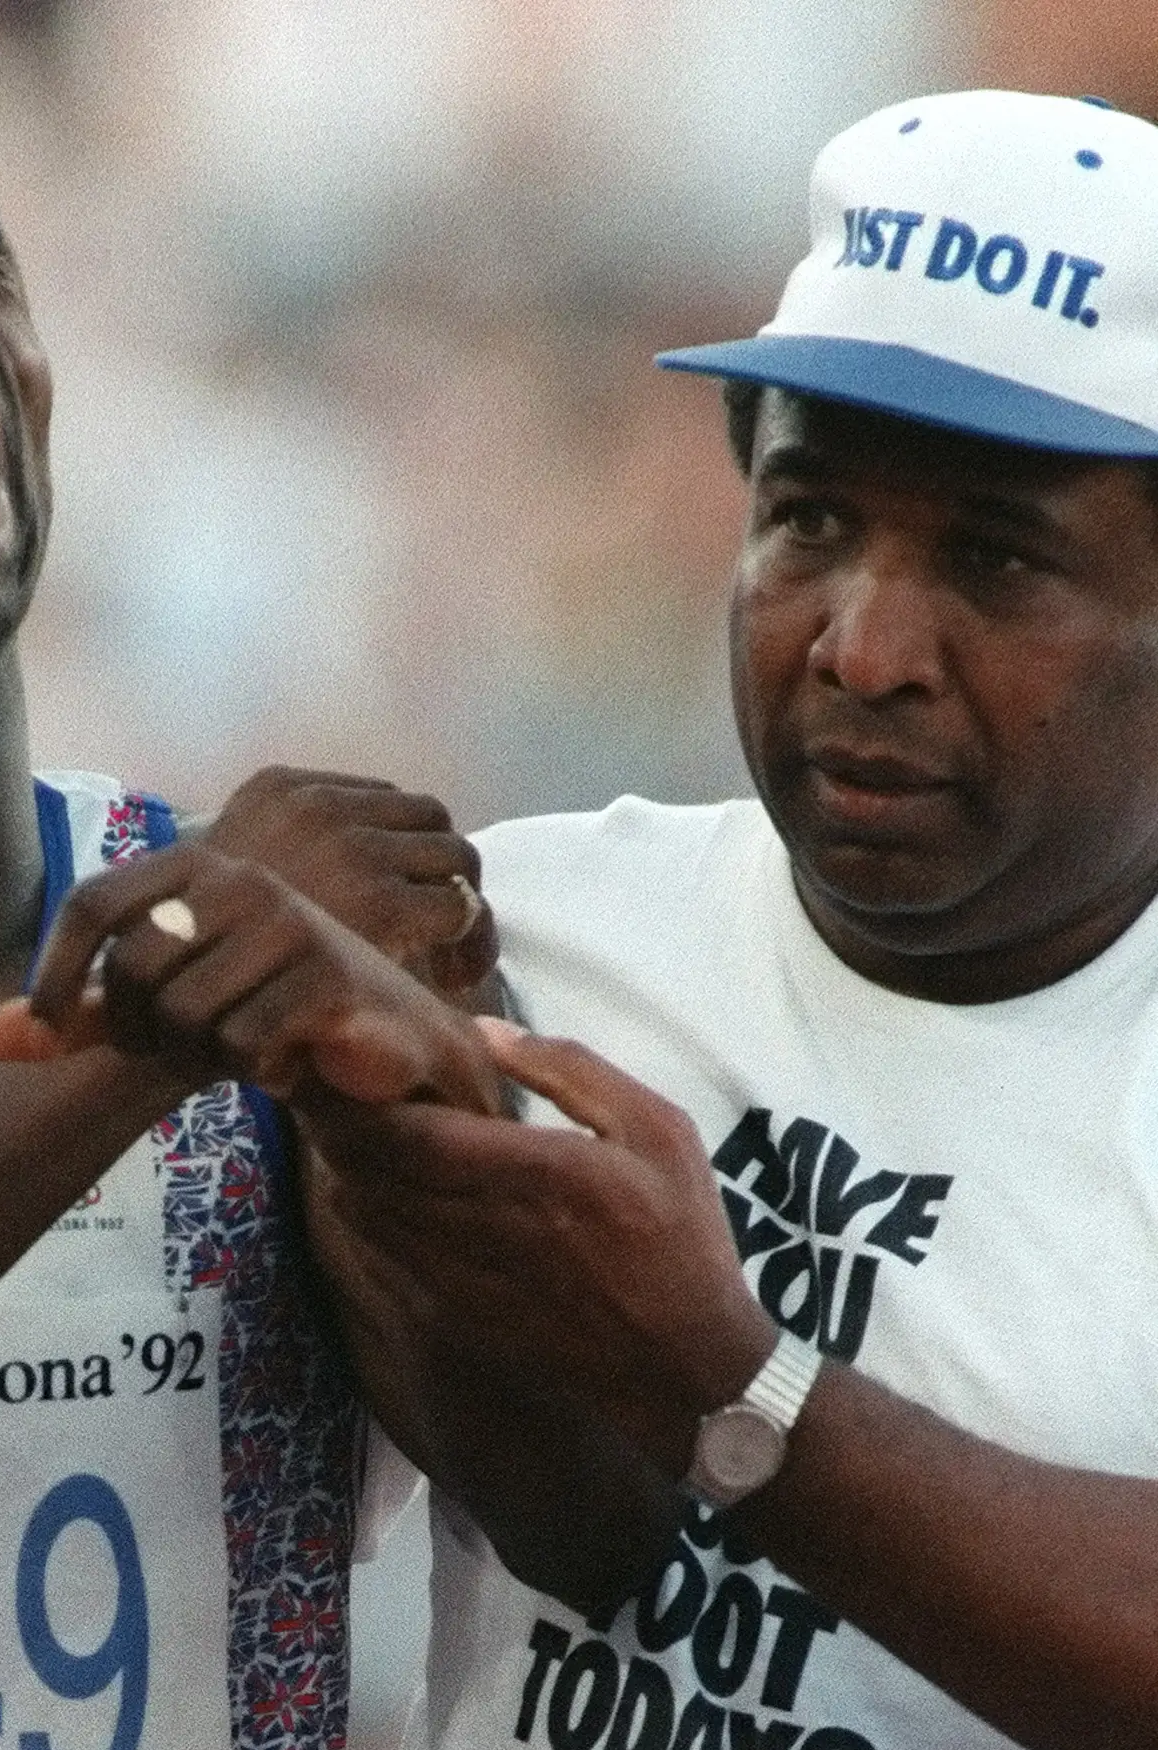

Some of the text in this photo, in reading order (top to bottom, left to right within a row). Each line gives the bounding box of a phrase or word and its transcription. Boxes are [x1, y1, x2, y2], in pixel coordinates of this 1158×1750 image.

[834, 206, 1106, 329] JUST DO IT.
[712, 1107, 954, 1268] HAVE
[583, 1535, 844, 1712] OOT
